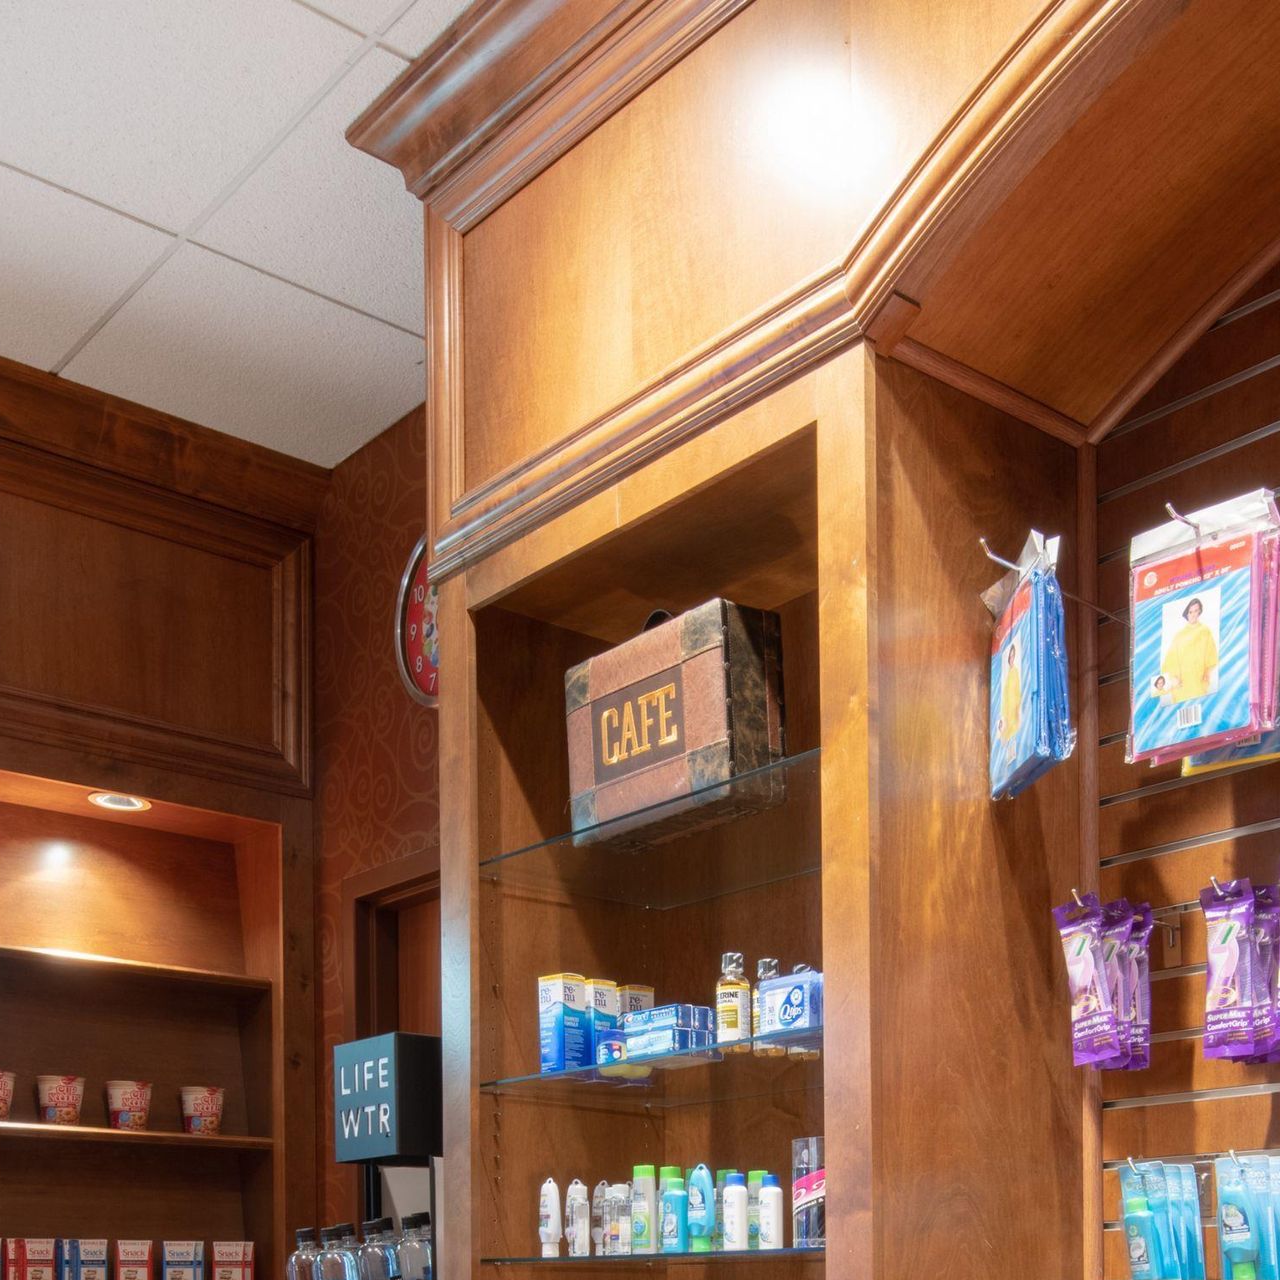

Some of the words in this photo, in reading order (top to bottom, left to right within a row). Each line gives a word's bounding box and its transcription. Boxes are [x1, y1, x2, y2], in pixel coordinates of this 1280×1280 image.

[600, 682, 678, 766] CAFE
[340, 1057, 389, 1095] LIFE
[341, 1103, 391, 1139] WTR
[29, 1249, 50, 1257] Snack
[168, 1250, 192, 1258] Snack
